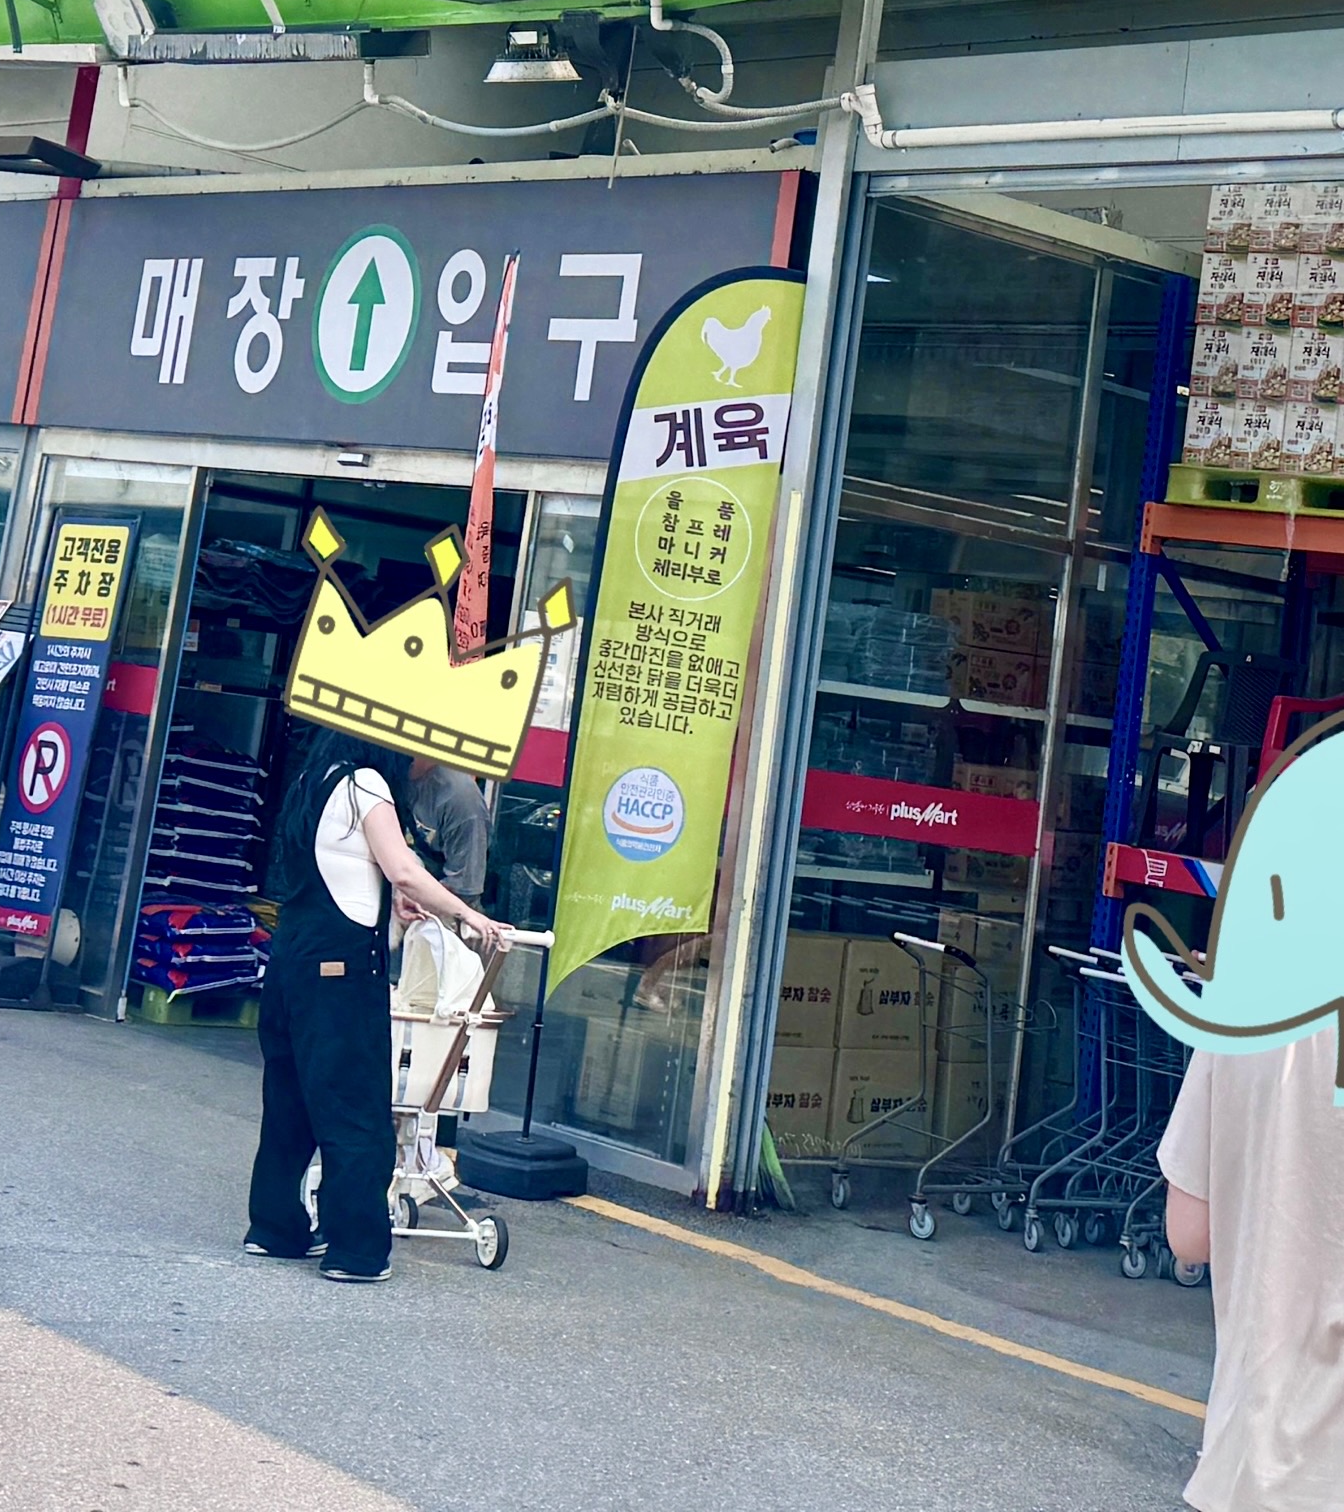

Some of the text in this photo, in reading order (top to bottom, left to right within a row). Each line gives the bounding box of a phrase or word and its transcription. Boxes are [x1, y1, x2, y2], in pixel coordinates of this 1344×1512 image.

[130, 251, 642, 402] 매장 입구
[654, 402, 769, 468] 계육
[59, 536, 122, 564] 고객전용
[53, 569, 115, 597] 주차장
[652, 558, 722, 586] 체리부로
[45, 604, 109, 628] (1시간 무료)
[628, 600, 722, 633] 본사 직거래
[636, 623, 707, 652] 방식으로
[599, 638, 740, 679] 중간마진을 없애고
[593, 659, 738, 701] 신선한 닭을 더욱더
[592, 681, 733, 721] 저렴하게 공급하고
[619, 706, 694, 735] 있습니다.
[616, 796, 674, 821] HACCP
[889, 801, 958, 827] plusMart
[611, 892, 692, 921] plusMart
